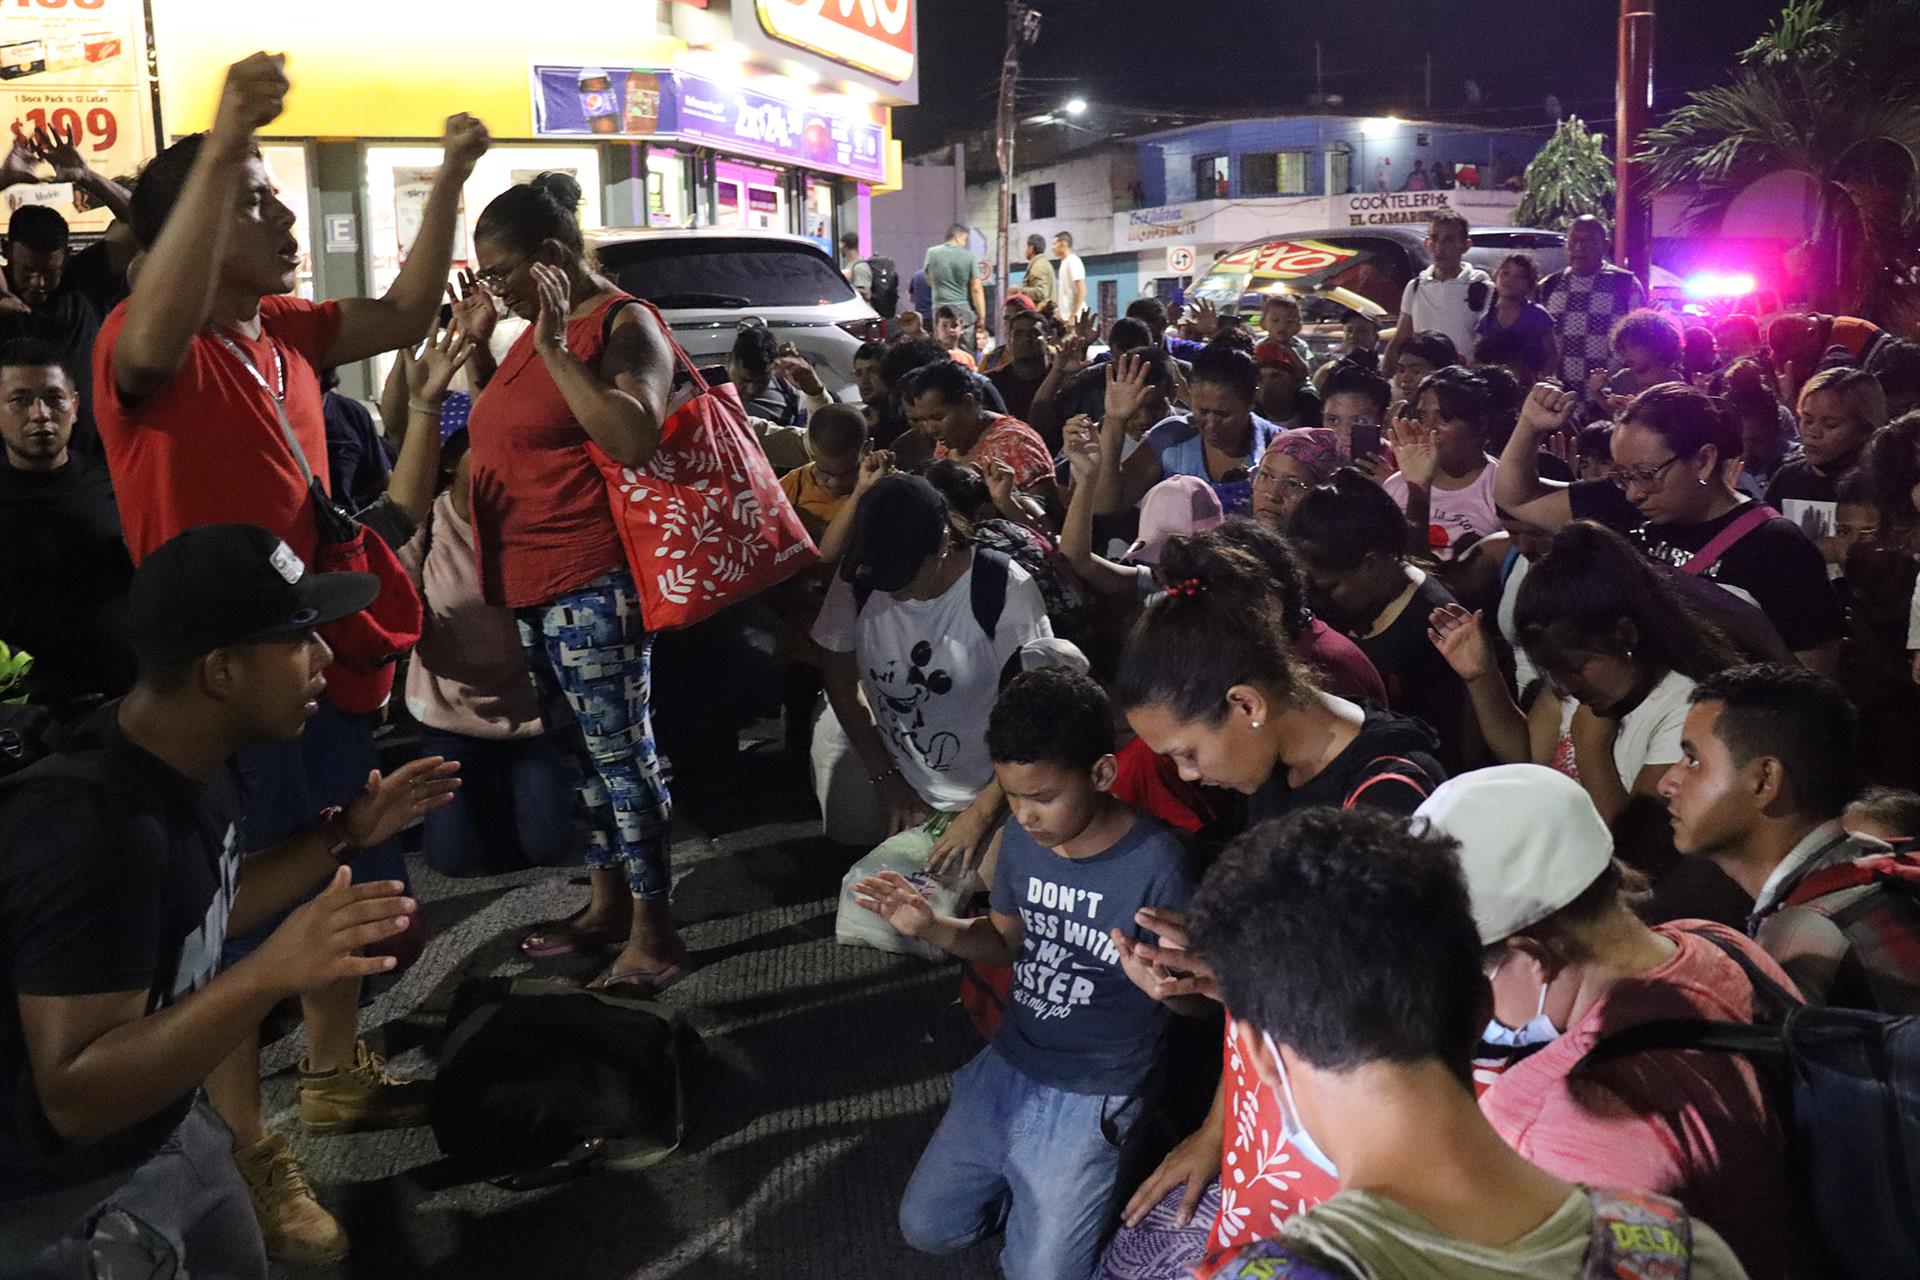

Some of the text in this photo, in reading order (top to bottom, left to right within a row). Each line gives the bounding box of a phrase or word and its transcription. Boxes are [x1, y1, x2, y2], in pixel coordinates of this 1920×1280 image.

[1349, 213, 1366, 226] EL
[1027, 876, 1104, 919] DON'T
[1018, 906, 1121, 966] ESS WITH
[1035, 939, 1074, 970] MY
[1012, 959, 1095, 1006] ISTER
[1041, 1002, 1072, 1020] job
